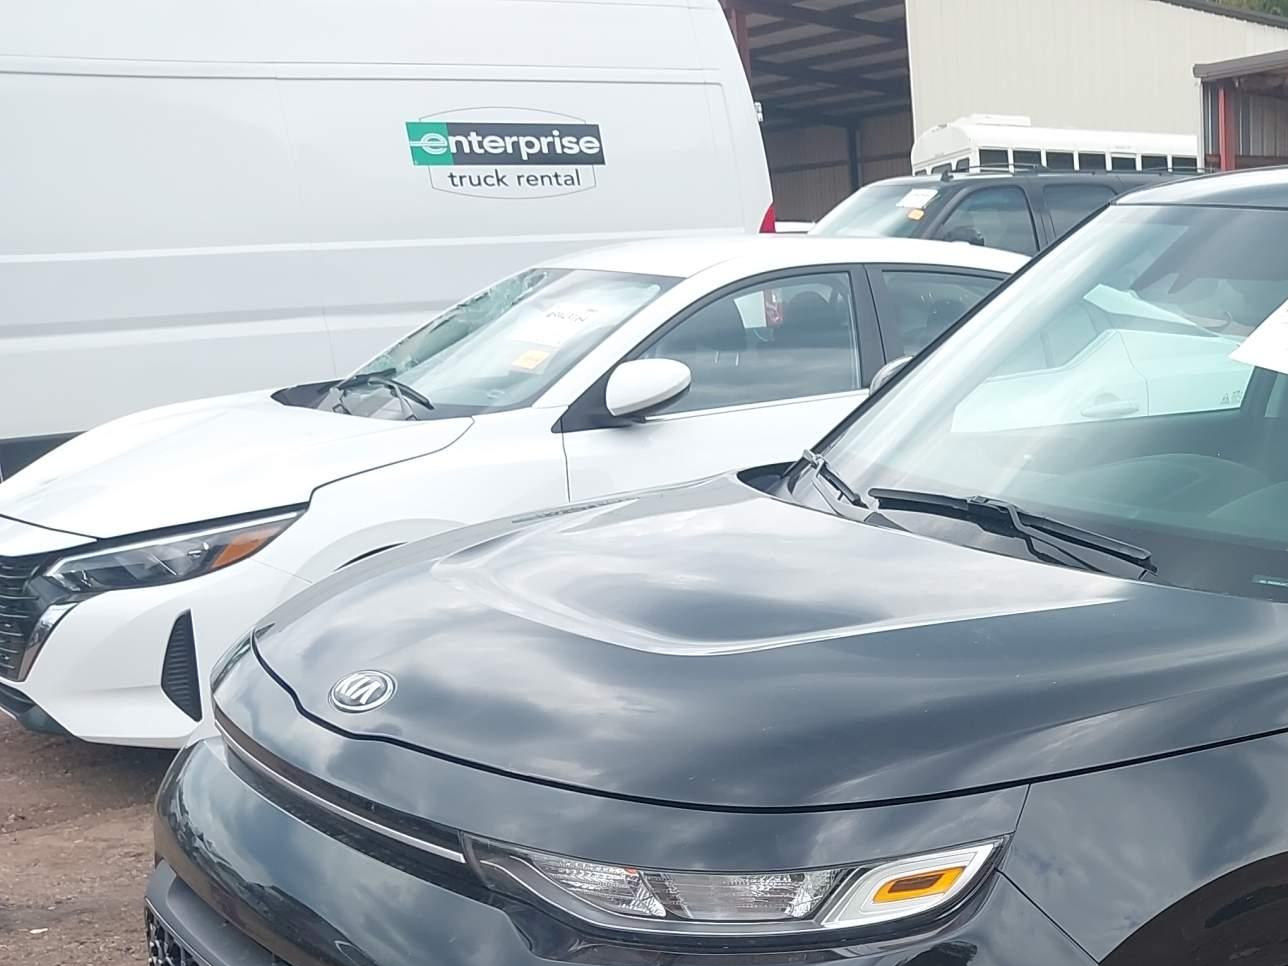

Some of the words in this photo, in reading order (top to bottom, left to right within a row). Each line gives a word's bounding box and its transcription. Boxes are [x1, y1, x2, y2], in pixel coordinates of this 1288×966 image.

[409, 130, 601, 161] enterprise
[448, 168, 509, 187] truck
[517, 168, 581, 187] rental
[335, 673, 381, 705] KIA
